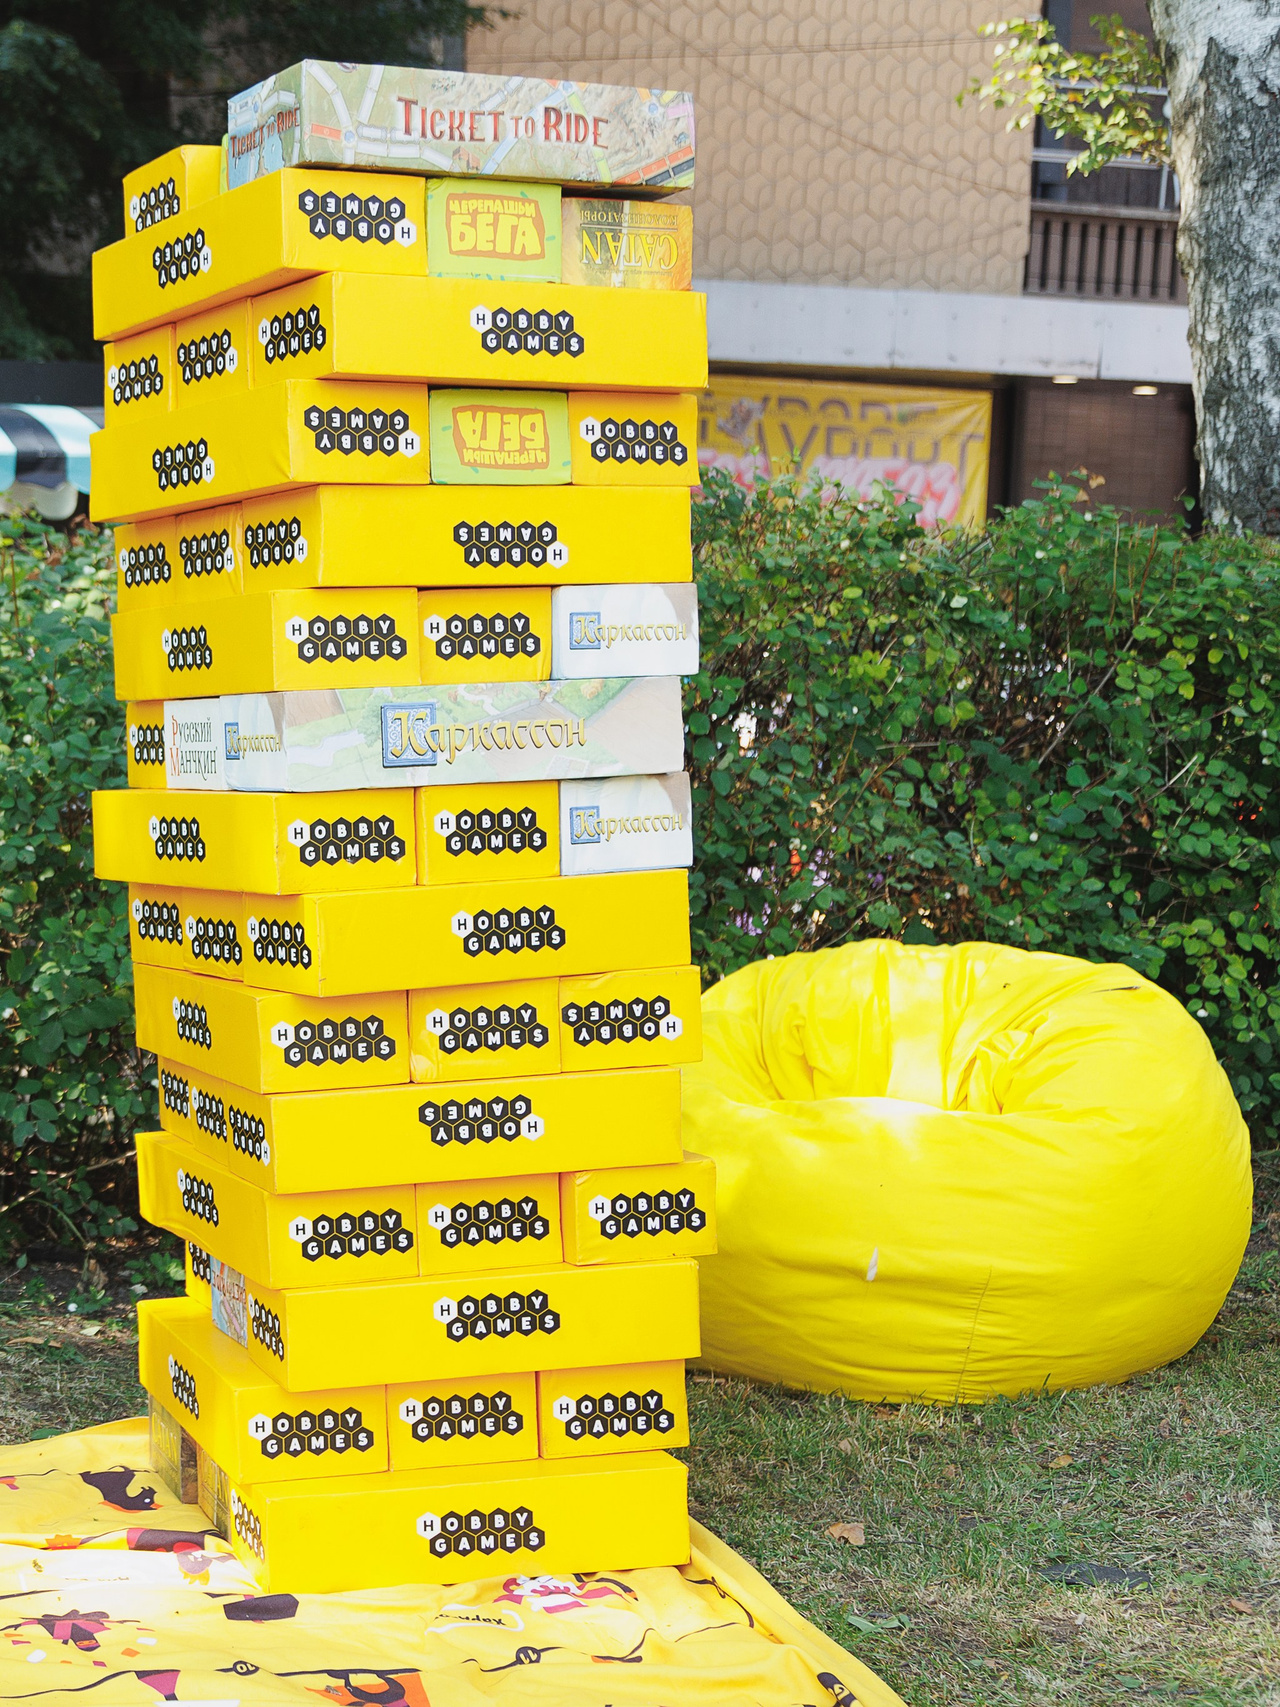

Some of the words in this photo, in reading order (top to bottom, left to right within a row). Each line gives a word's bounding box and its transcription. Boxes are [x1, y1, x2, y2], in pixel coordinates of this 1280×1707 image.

[229, 124, 265, 159] TICKET
[276, 107, 301, 134] RIDE
[396, 95, 505, 144] TICKET
[542, 106, 610, 150] RIDE
[130, 180, 176, 217] HOBBY
[302, 193, 402, 218] GAMES
[448, 199, 536, 218] ЧЕРЕПАШЬИ
[135, 197, 180, 232] GAMES
[580, 209, 678, 227] КОЛОНИЗАТОРЫ
[313, 216, 413, 242] HOBBY
[449, 212, 542, 256] БЕГА
[152, 230, 205, 268] GAMES
[580, 229, 679, 270] CATAN
[158, 250, 210, 285] HOBBY
[260, 308, 319, 340] HOBBY
[473, 311, 572, 332] HOBBY
[177, 334, 231, 363] GAMES
[266, 330, 325, 359] GAMES
[484, 331, 581, 354] GAMES
[109, 359, 158, 384] HOBBY
[182, 352, 236, 382] HOBBY
[112, 376, 163, 403] GAMES
[307, 410, 406, 431] GAMES
[458, 410, 546, 452] БЕГА
[584, 422, 676, 443] HOBBY
[318, 430, 417, 452] HOBBY
[594, 442, 685, 463] GAMES
[152, 442, 207, 469] GAMES
[158, 462, 214, 488] HOBBY
[179, 533, 229, 556] GAMES
[245, 522, 300, 546] GAMES
[456, 526, 554, 542] GAMES
[120, 546, 165, 567] HOBBY
[183, 552, 234, 576] HOBBY
[250, 541, 306, 564] HOBBY
[468, 545, 564, 564] HOBBY
[124, 564, 171, 585] GAMES
[290, 618, 392, 638] HOBBY
[428, 617, 528, 636] HOBBY
[573, 615, 688, 649] Каркассон
[162, 630, 206, 651] HOBBY
[302, 639, 403, 659] GAMES
[439, 636, 537, 656] GAMES
[168, 650, 212, 669] GAMES
[226, 726, 282, 760] Каркассон
[390, 710, 588, 766] Каркассон
[134, 746, 166, 762] GAME
[148, 819, 200, 839] HOBBY
[291, 818, 393, 844] HOBBY
[437, 810, 536, 834] HOBBY
[573, 807, 685, 844] Каркассон
[155, 840, 206, 860] GAMES
[303, 837, 402, 864] GAMES
[448, 830, 544, 853] GAMES
[133, 904, 180, 922] HOBBY
[456, 910, 552, 932] HOBBY
[138, 921, 184, 942] GAMES
[187, 922, 236, 941] HOBBY
[248, 922, 304, 943] HOBBY
[466, 929, 562, 952] GAMES
[192, 940, 242, 961] GAMES
[254, 942, 311, 965] GAMES
[172, 1002, 208, 1025] HOBBY
[431, 1007, 534, 1031] HOBBY
[566, 999, 668, 1023] GAMES
[176, 1022, 212, 1045] GAMES
[276, 1019, 380, 1043] HOBBY
[442, 1027, 544, 1050] GAMES
[577, 1020, 678, 1042] HOBBY
[288, 1040, 392, 1063] GAMES
[164, 1091, 190, 1114] OBBY
[192, 1092, 224, 1116] HOBBY
[423, 1099, 528, 1122] GAMES
[196, 1112, 228, 1136] GAMES
[228, 1109, 266, 1139] GAMES
[433, 1120, 540, 1142] HOBBY
[232, 1130, 270, 1160] HOBBY
[178, 1174, 214, 1202] HOBBY
[182, 1194, 220, 1223] GAMES
[433, 1200, 534, 1225] HOBBY
[593, 1192, 692, 1216] HOBBY
[294, 1212, 398, 1238] HOBBY
[444, 1219, 546, 1244] GAMES
[603, 1212, 702, 1236] GAMES
[305, 1232, 410, 1257] GAMES
[248, 1300, 281, 1333] HOBBY
[438, 1293, 545, 1318] HOBBY
[450, 1313, 556, 1338] GAMES
[252, 1320, 284, 1356] GAMES
[168, 1360, 196, 1394] HOBBY
[172, 1381, 200, 1418] GAMES
[404, 1395, 509, 1420] HOBBY
[557, 1394, 660, 1417] HOBBY
[253, 1412, 359, 1435] HOBBY
[415, 1414, 521, 1438] GAMES
[568, 1412, 672, 1436] GAMES
[264, 1431, 370, 1454] GAMES
[231, 1494, 262, 1536] HOBBY
[422, 1511, 531, 1534] HOBBY
[235, 1516, 265, 1561] GAMES
[434, 1529, 542, 1553] GAMES
